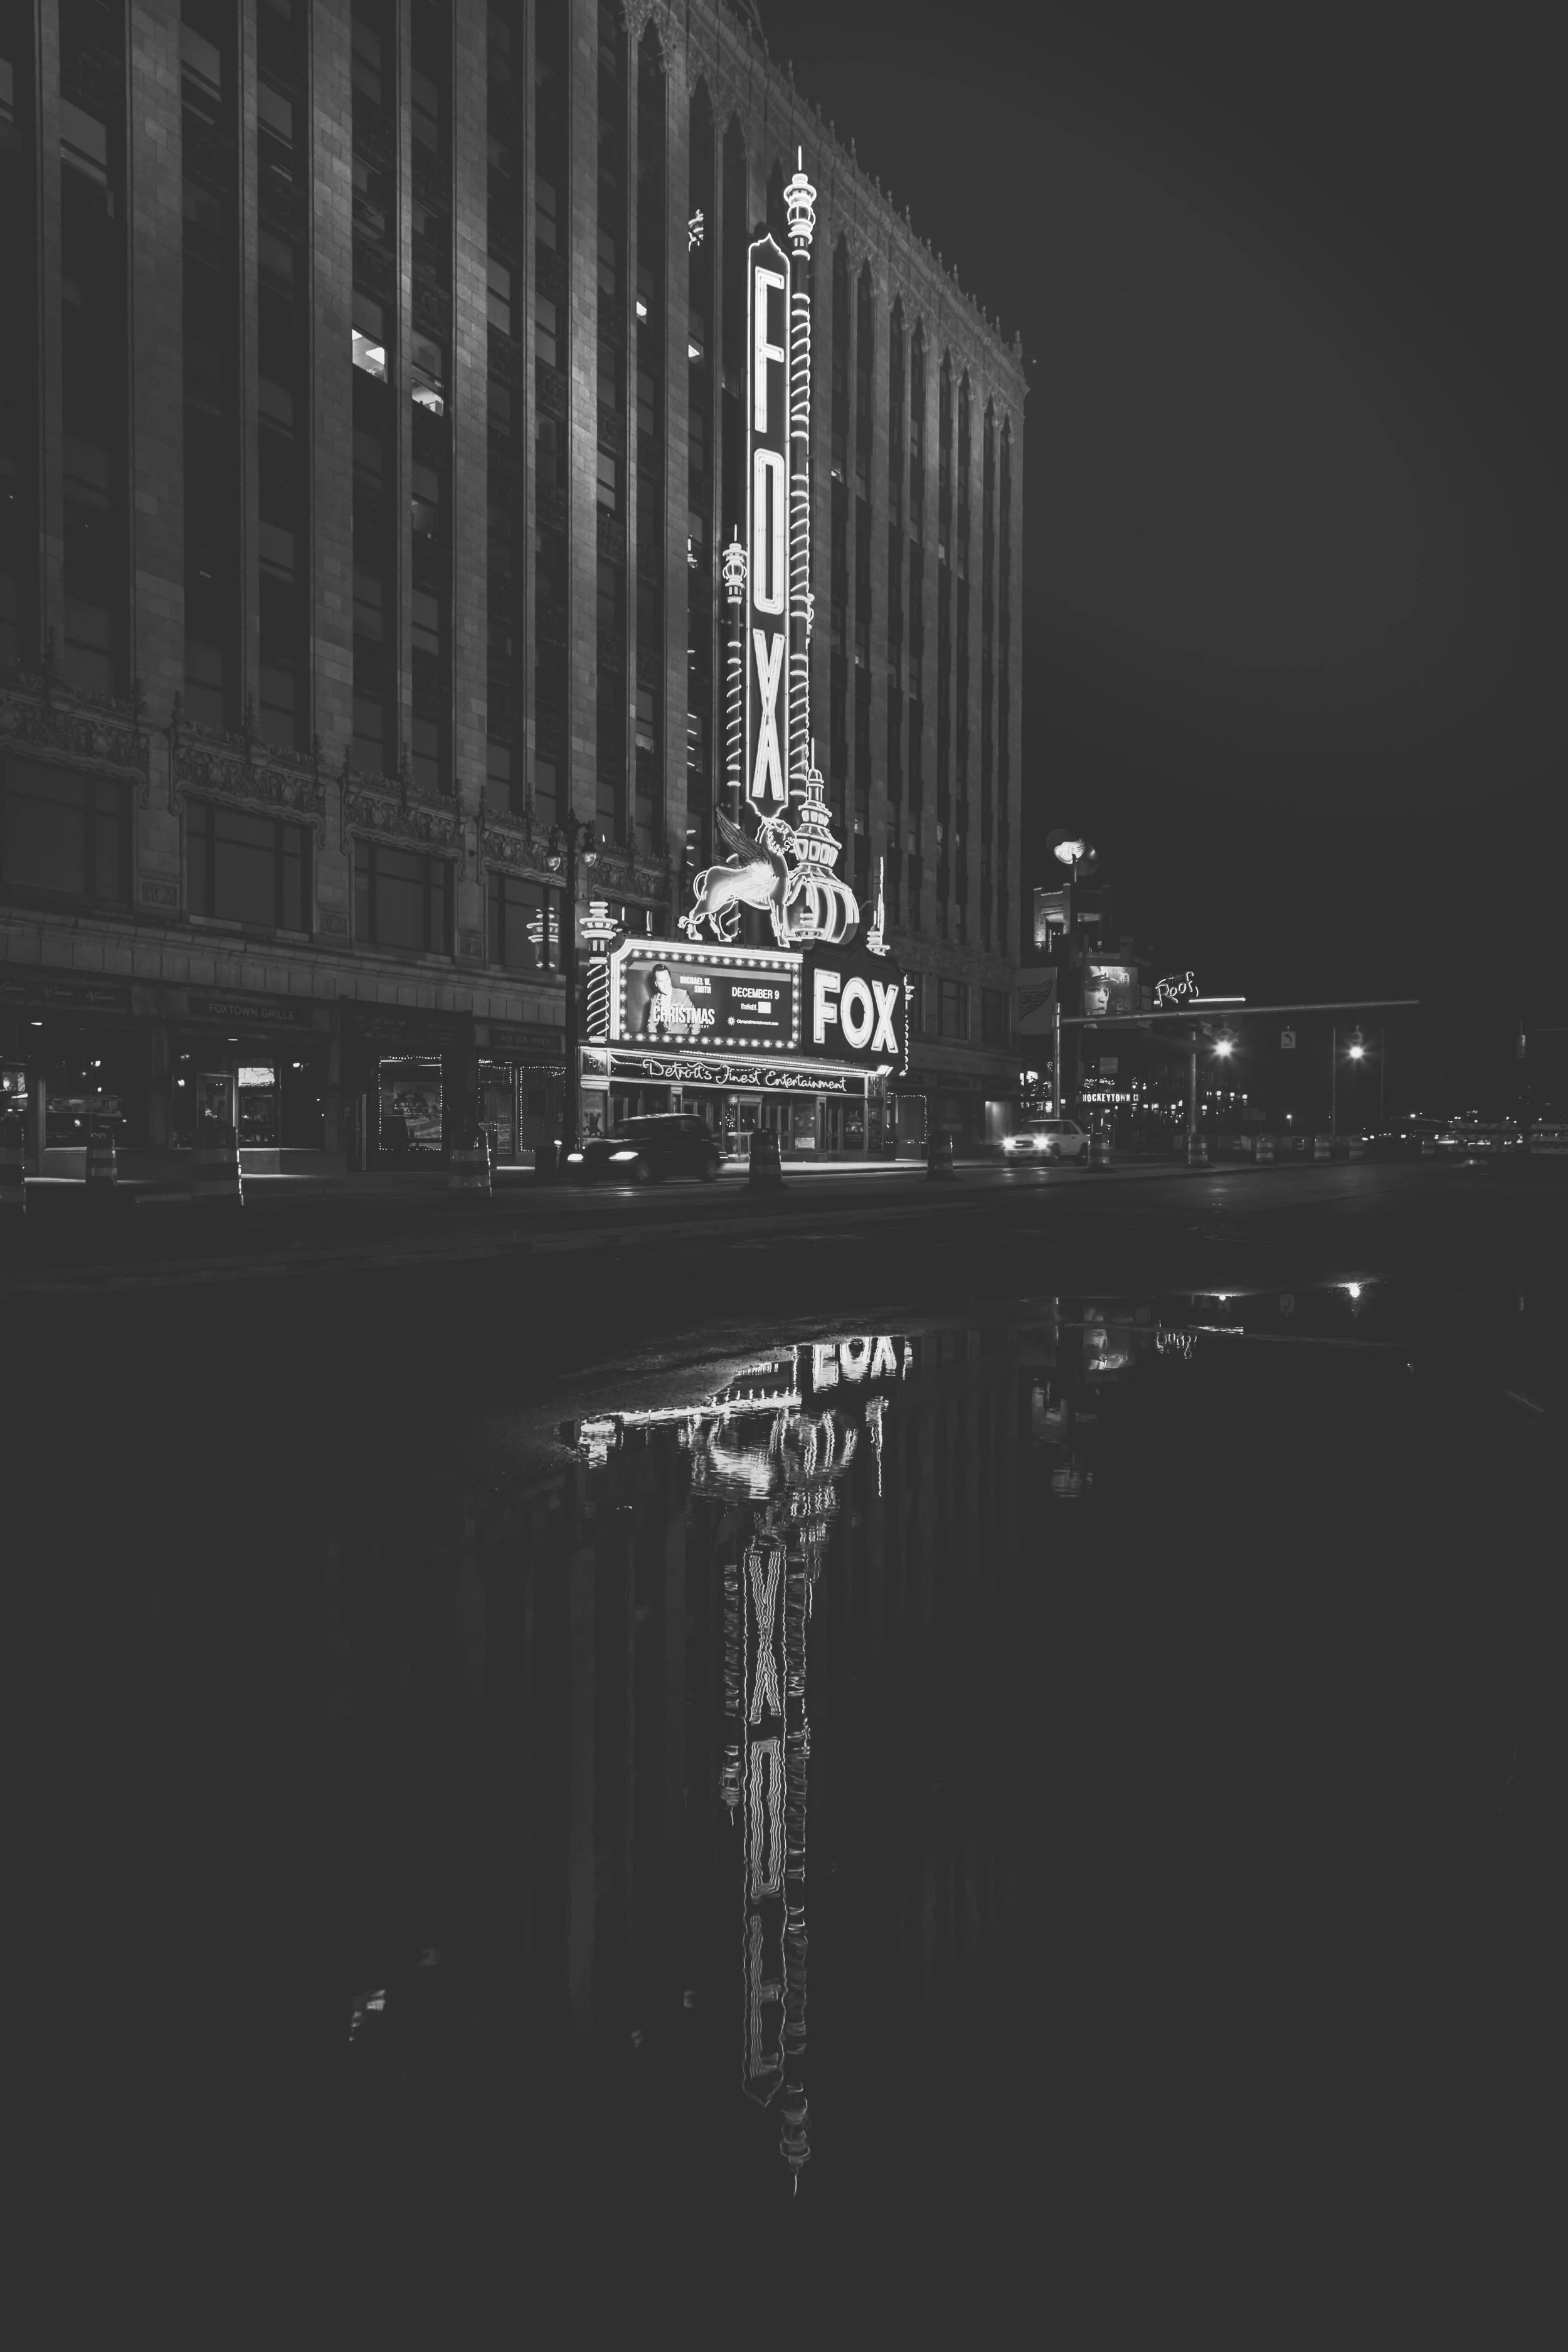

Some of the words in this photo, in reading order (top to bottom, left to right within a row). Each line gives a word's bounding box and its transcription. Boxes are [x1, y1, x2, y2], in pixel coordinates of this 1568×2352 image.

[753, 265, 785, 801] FOX
[680, 976, 703, 985] MICHAEL
[694, 985, 712, 993] SMITH
[731, 987, 773, 1000] DECEMBER
[774, 990, 780, 1000] 9
[208, 1002, 258, 1017] FOXTOWN
[261, 1009, 296, 1020] GRILLE
[653, 1005, 715, 1025] CHRISTMAS
[813, 968, 899, 1054] FOX
[642, 1059, 712, 1083] Detroit's
[716, 1064, 761, 1086] Finest
[765, 1069, 847, 1093] Entertainment
[1083, 1093, 1130, 1103] HOCKEYTOWN
